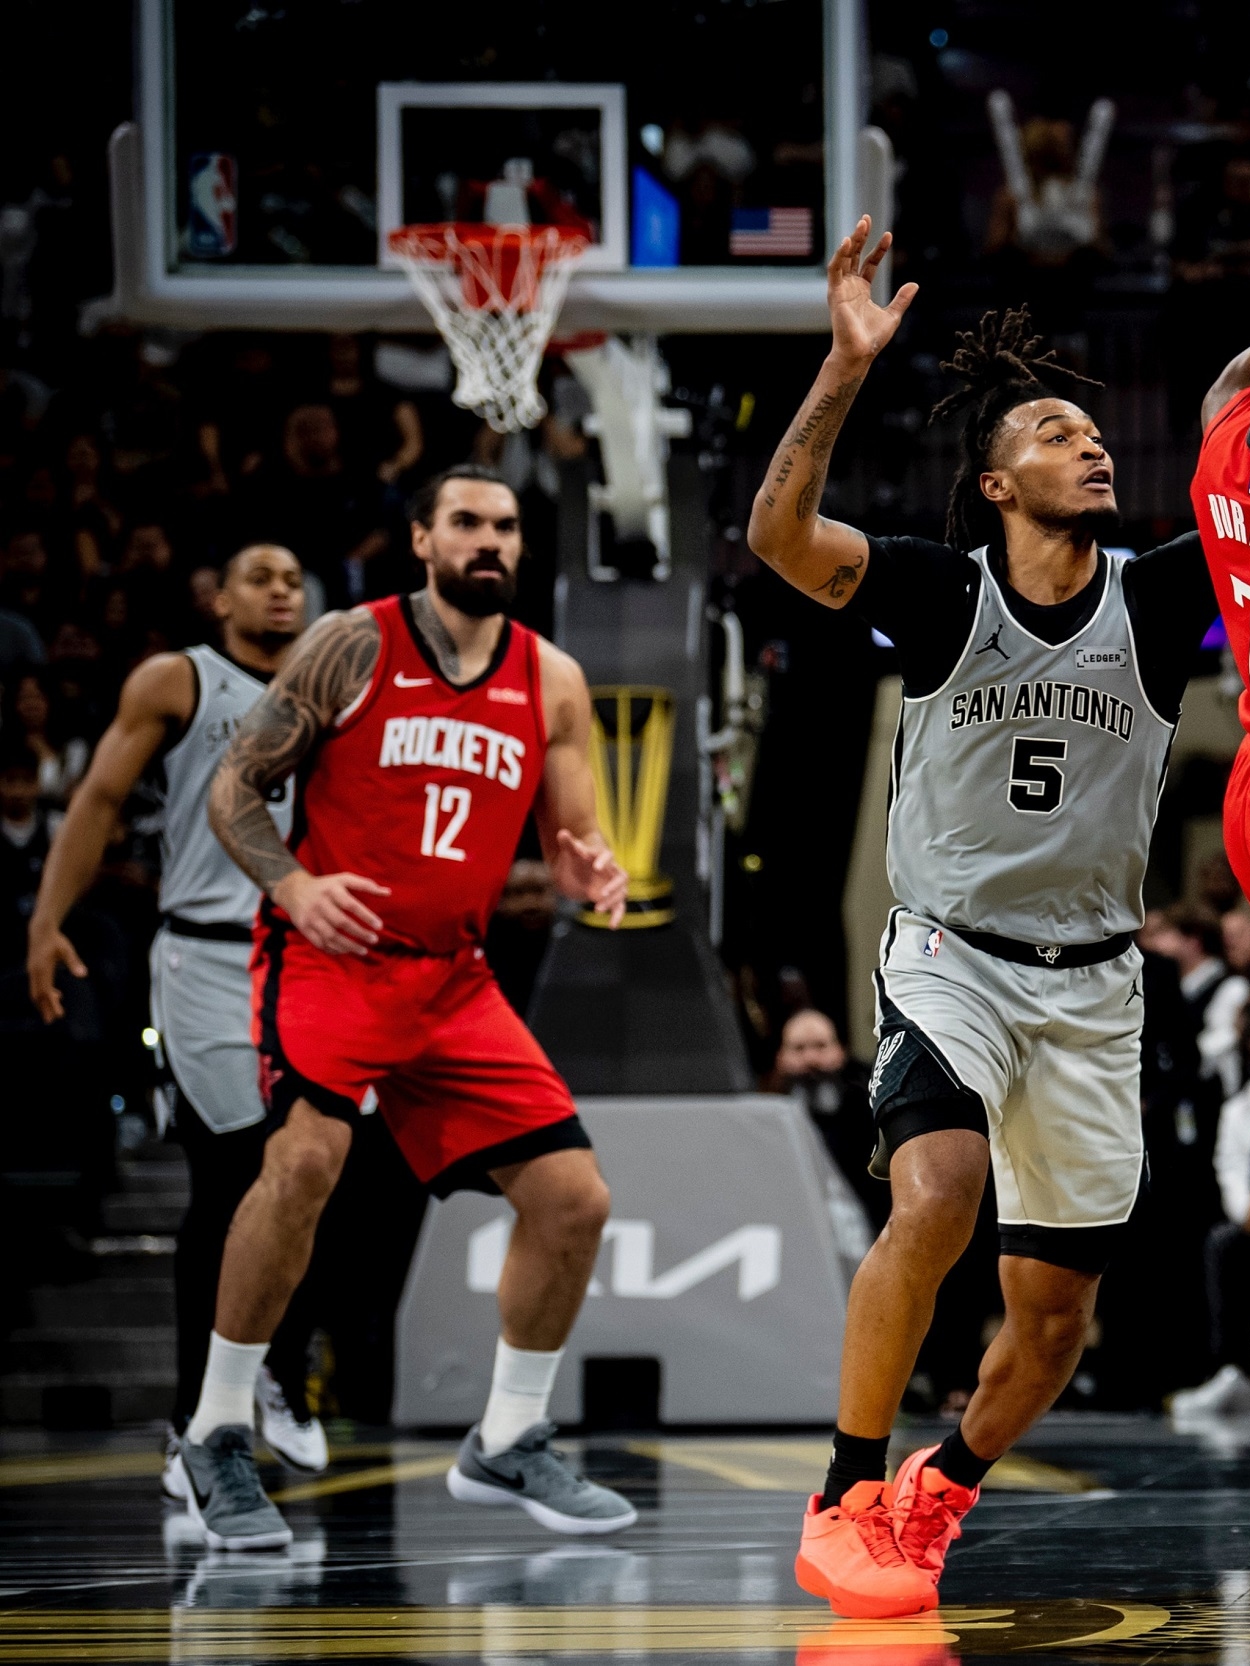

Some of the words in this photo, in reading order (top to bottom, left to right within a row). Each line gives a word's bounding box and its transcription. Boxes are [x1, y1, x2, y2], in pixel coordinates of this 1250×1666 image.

[1083, 653, 1121, 664] LEDGER
[950, 684, 1008, 731] SAN
[1009, 680, 1135, 744] ANTONIO
[379, 716, 526, 791] ROCKETS
[1007, 736, 1069, 815] 5
[420, 782, 472, 862] 12
